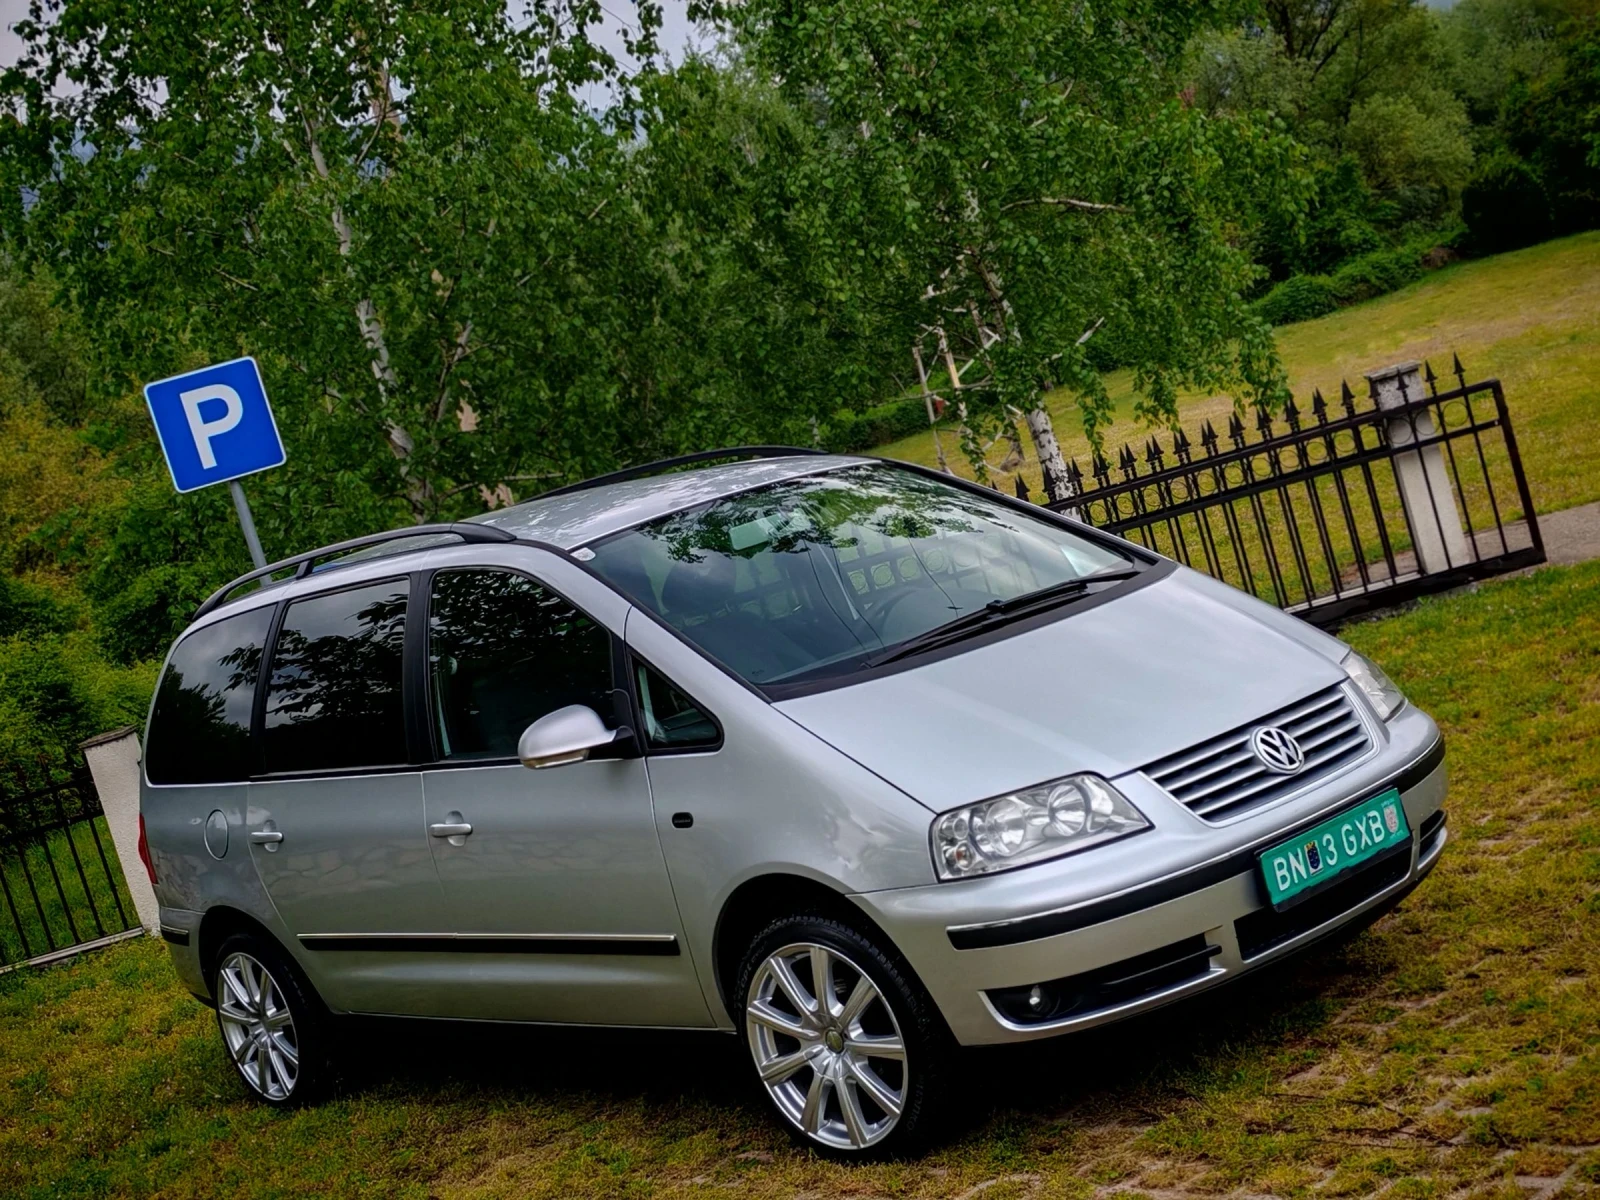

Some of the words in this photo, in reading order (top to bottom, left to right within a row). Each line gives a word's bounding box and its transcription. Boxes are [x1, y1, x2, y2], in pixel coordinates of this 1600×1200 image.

[180, 383, 244, 470] P
[1273, 848, 1307, 891] BN
[1322, 833, 1339, 866] 3
[1341, 810, 1386, 856] GXB
